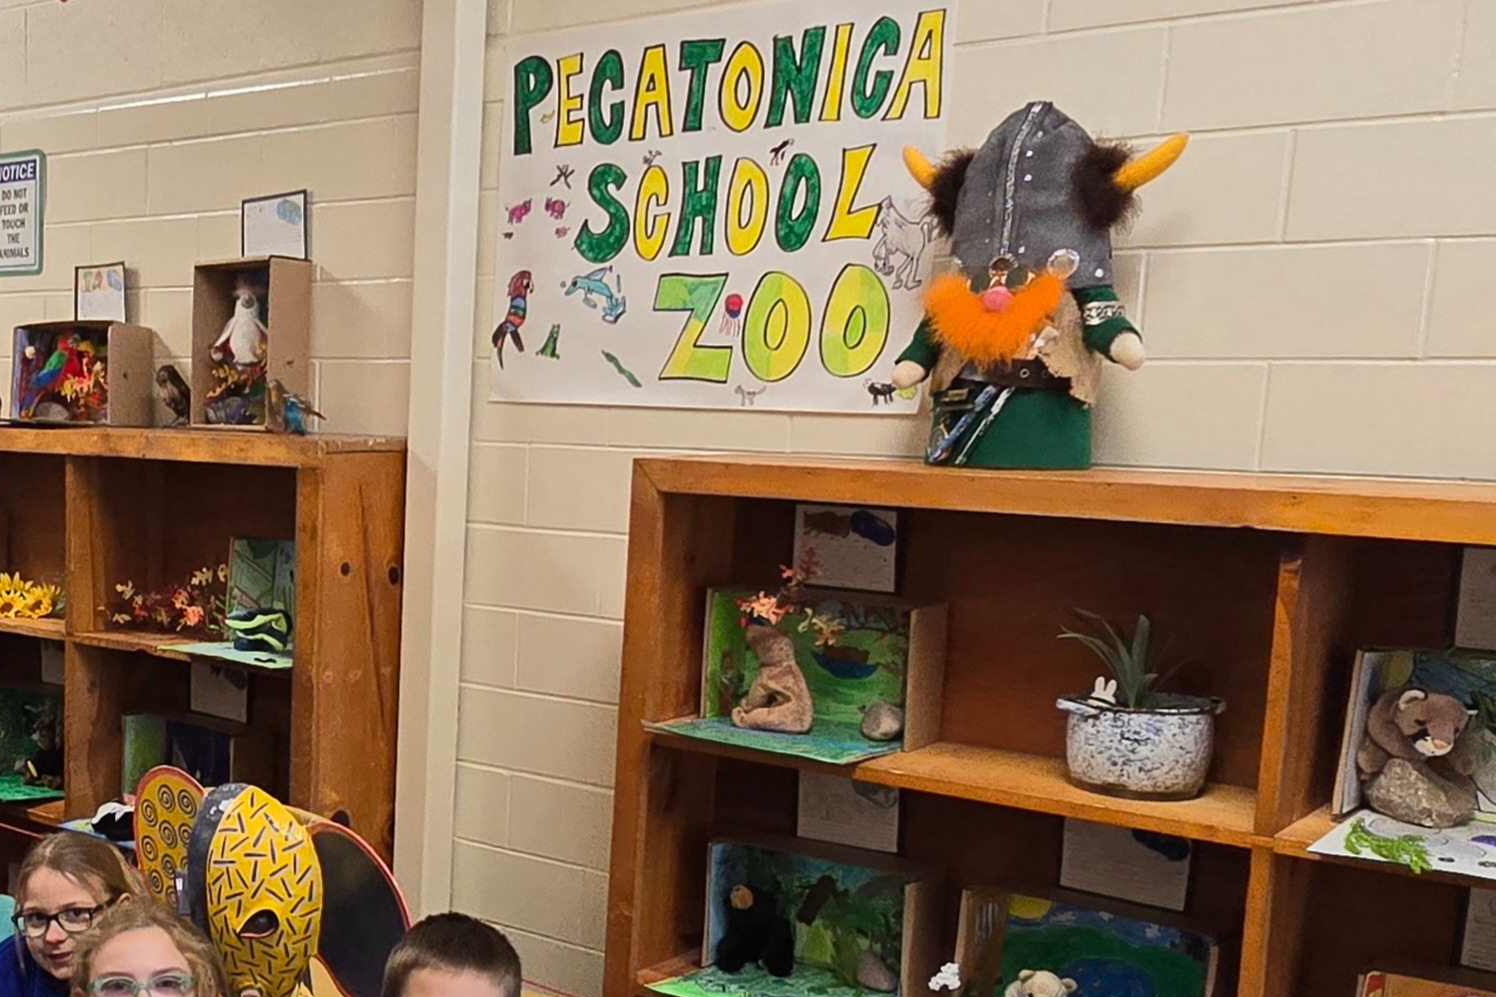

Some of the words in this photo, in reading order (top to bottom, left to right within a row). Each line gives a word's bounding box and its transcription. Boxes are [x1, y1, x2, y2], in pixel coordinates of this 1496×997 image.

[513, 8, 946, 155] PECATONICA
[1, 189, 12, 201] DO
[13, 187, 27, 200] NOT
[0, 204, 17, 216] FEED
[18, 202, 29, 214] OR
[573, 144, 881, 263] SCHOOL
[1, 218, 25, 230] TOUCH
[7, 233, 20, 244] THE
[653, 264, 891, 382] ZOO
